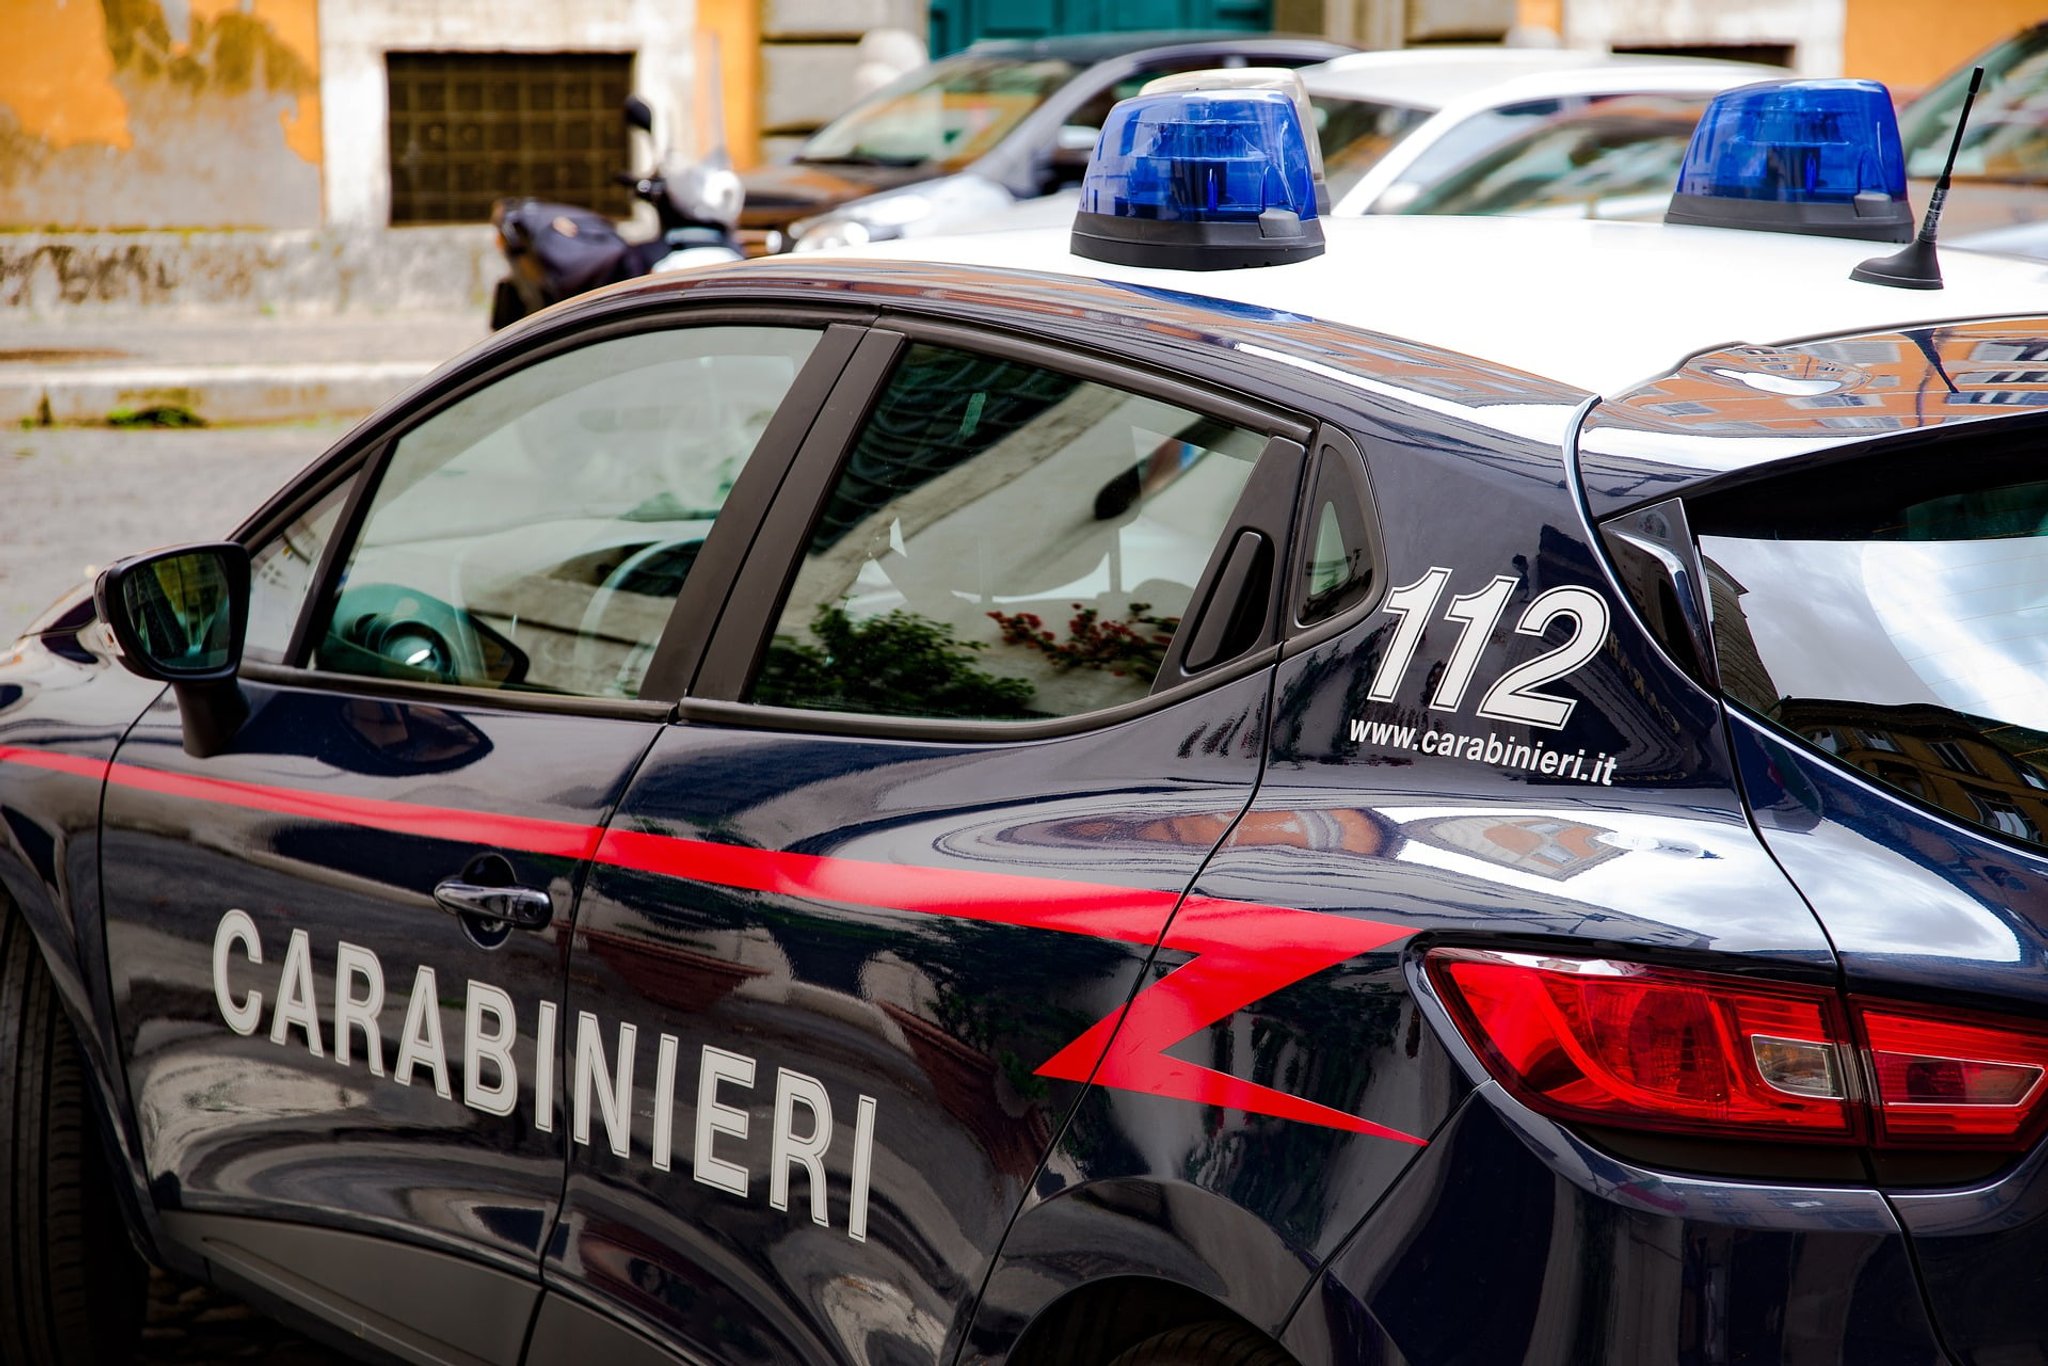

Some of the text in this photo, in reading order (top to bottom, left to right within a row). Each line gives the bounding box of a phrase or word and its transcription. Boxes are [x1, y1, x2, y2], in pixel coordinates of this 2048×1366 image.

[1367, 566, 1611, 731] 112
[1350, 719, 1617, 786] www.carabinieri.it
[212, 909, 877, 1243] CARABINIERI
